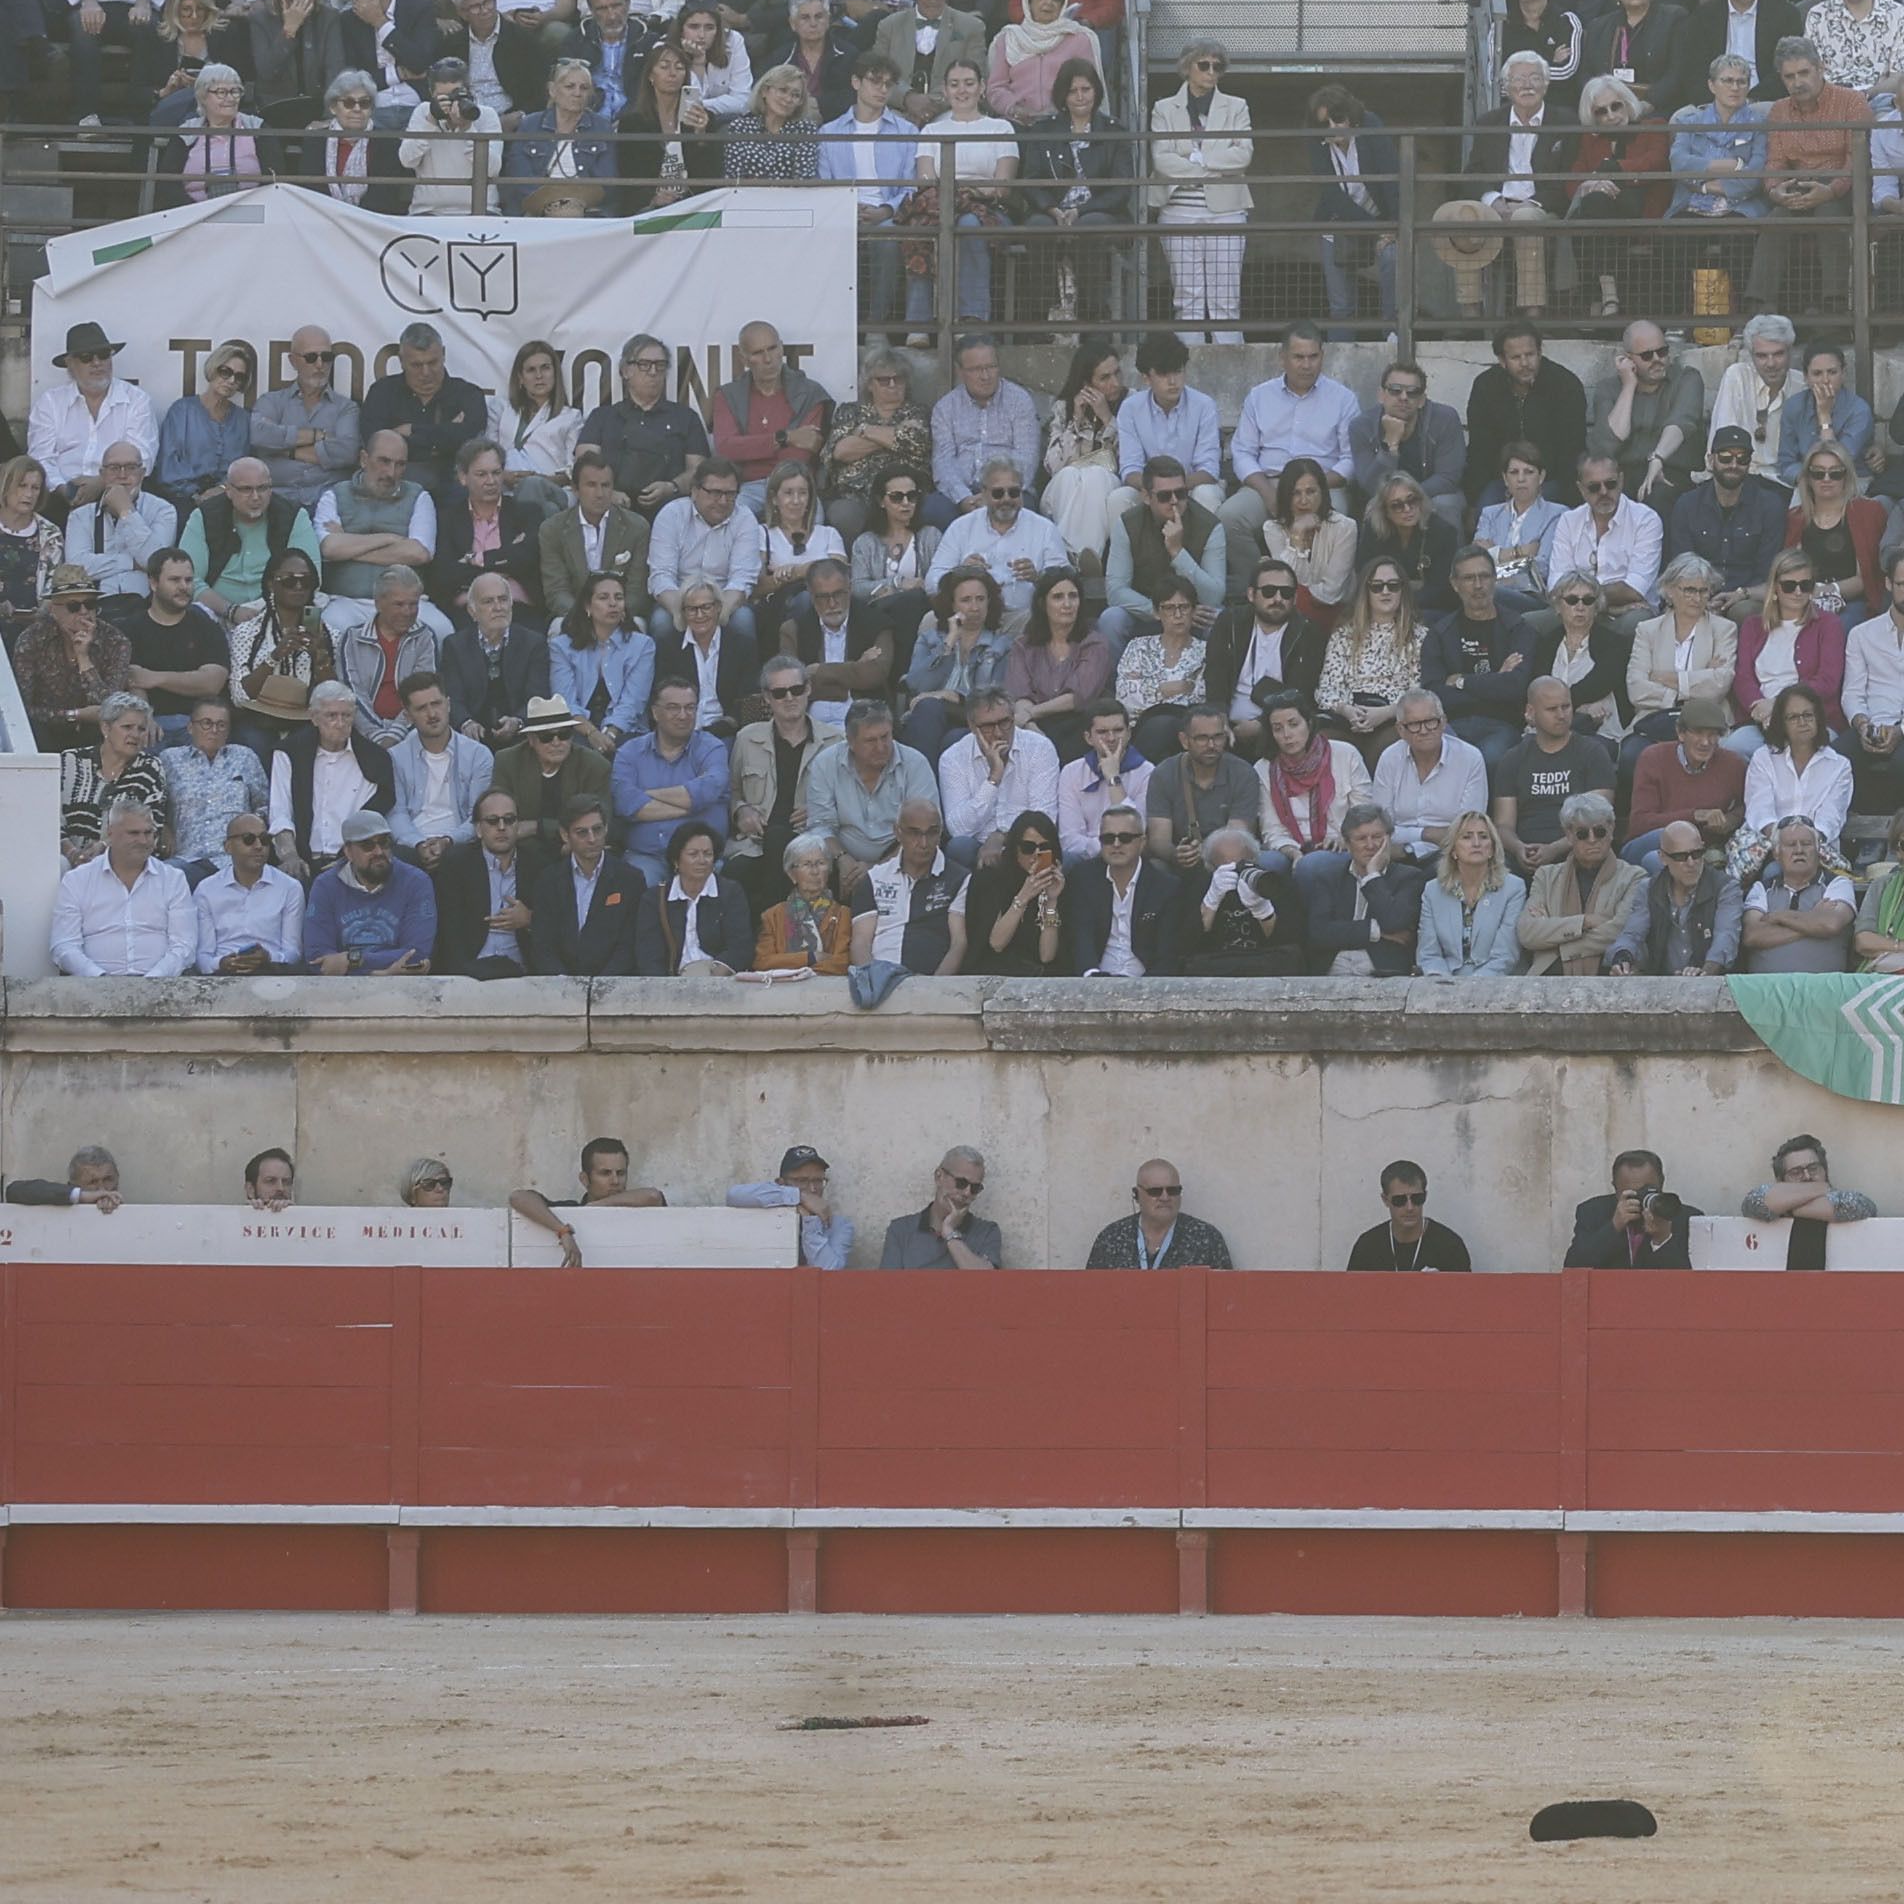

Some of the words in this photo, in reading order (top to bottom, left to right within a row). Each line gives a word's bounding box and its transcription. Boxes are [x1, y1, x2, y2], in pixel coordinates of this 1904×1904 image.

[1532, 770, 1571, 785] TEDDY
[1532, 783, 1571, 796] SMITH
[185, 1061, 195, 1075] 2
[243, 1226, 336, 1239] SERVICE
[1745, 1233, 1760, 1251] 6
